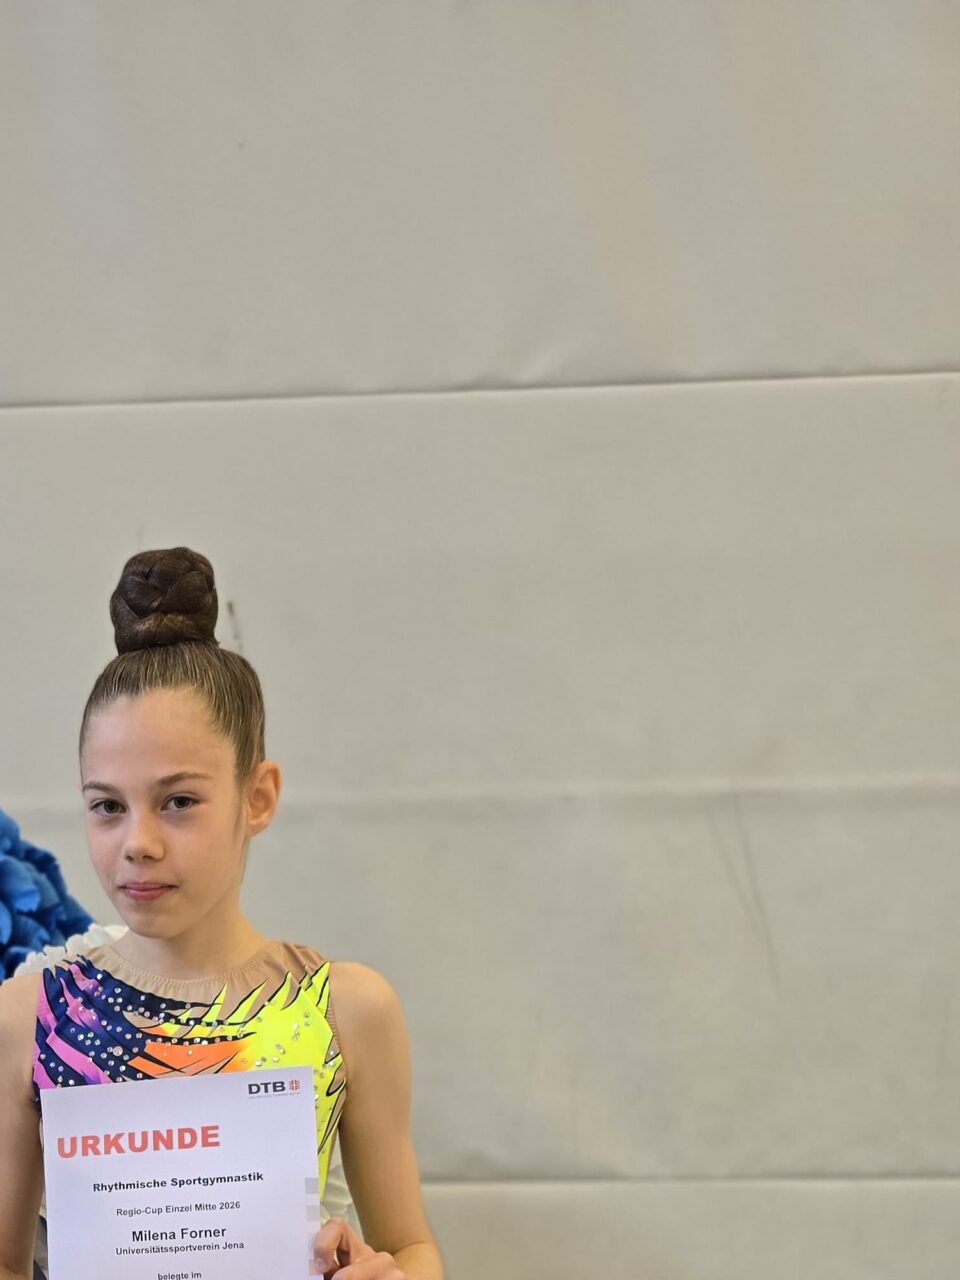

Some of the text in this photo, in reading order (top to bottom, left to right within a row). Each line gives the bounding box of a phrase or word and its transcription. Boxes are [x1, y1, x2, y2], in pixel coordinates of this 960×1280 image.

[248, 1081, 285, 1094] DTB
[57, 1125, 220, 1159] URKUNDE
[93, 1172, 264, 1192] Rhythmische Sportgymnastik
[116, 1201, 240, 1217] Regio-Cup Einzel Mitte 2026
[132, 1228, 226, 1242] Milena Forner
[116, 1243, 220, 1255] Universitätssportverein
[157, 1273, 189, 1280] belegte
